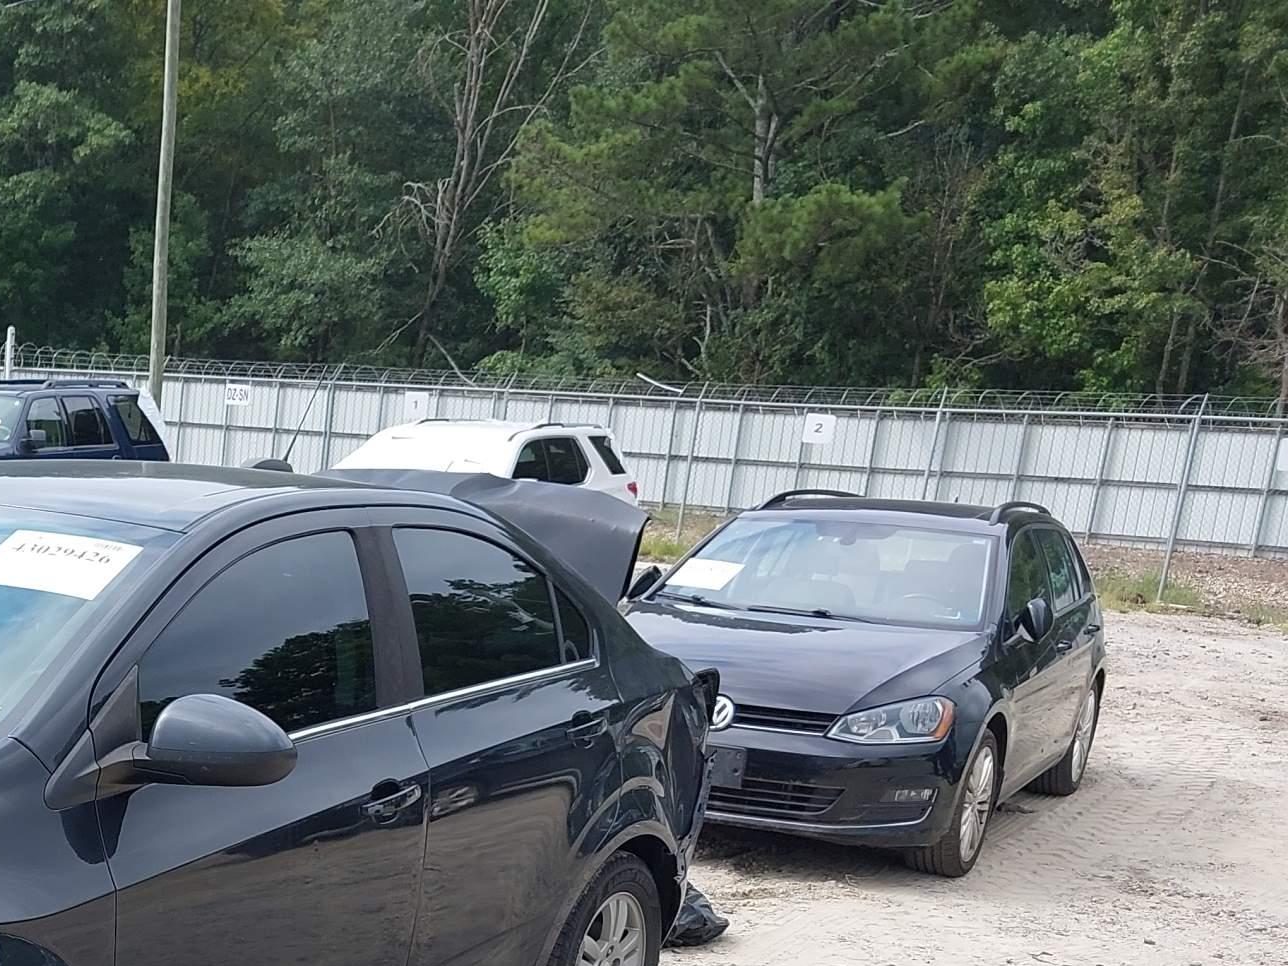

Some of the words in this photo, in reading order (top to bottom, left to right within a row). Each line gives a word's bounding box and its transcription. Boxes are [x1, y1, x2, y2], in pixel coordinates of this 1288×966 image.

[226, 387, 249, 401] DZ-SN
[814, 422, 824, 434] 2
[12, 542, 112, 565] 43029426
